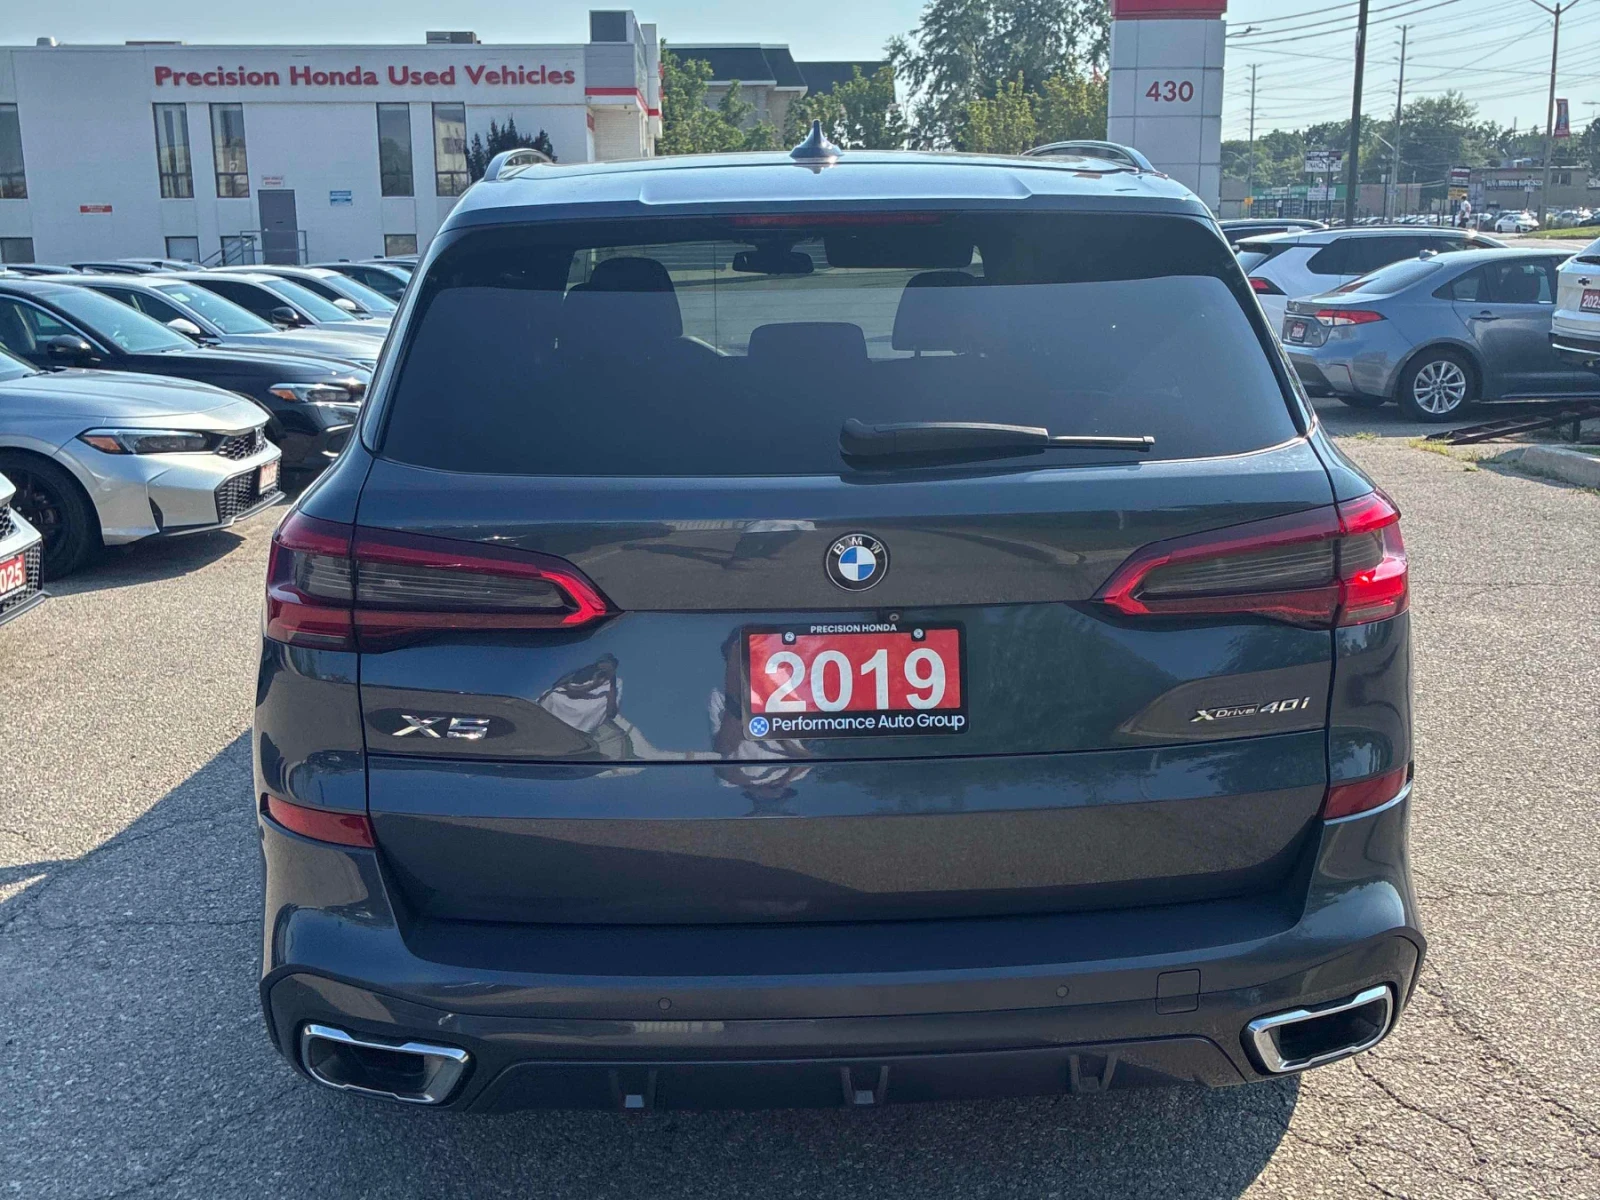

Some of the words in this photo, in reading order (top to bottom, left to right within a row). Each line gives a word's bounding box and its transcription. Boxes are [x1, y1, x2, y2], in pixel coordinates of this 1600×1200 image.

[154, 66, 279, 86] Precision
[290, 65, 378, 86] Honda
[388, 65, 455, 86] Used
[465, 64, 576, 85] Vehicles
[1146, 81, 1194, 103] 430
[810, 625, 860, 634] PRECISION
[862, 624, 897, 632] HONDA
[764, 648, 946, 712] 2019
[392, 714, 491, 740] X5
[772, 717, 875, 732] Performance
[877, 715, 914, 729] Auto
[916, 713, 966, 732] Group
